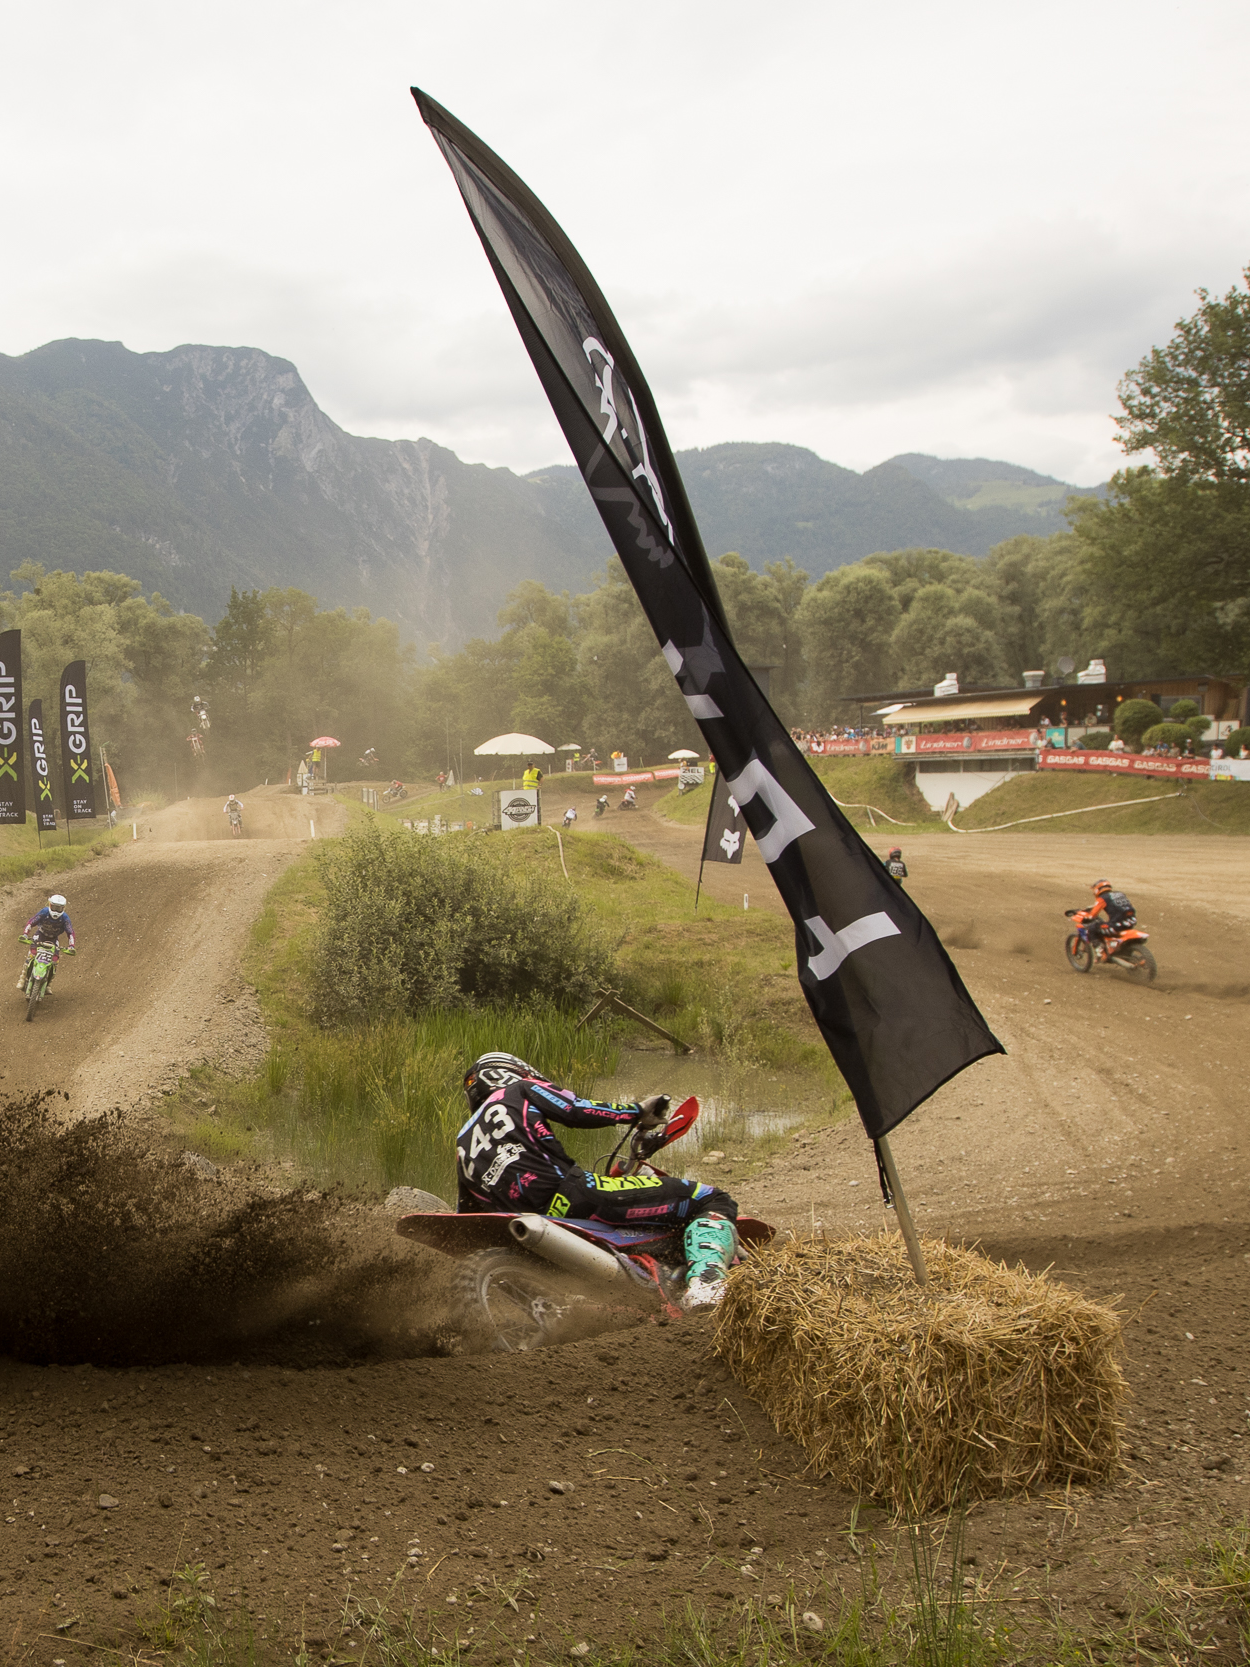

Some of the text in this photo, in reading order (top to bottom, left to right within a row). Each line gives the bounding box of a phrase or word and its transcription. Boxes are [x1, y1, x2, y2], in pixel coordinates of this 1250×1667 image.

[65, 684, 90, 783] X-GRIP
[827, 743, 858, 752] Lindner
[871, 742, 889, 751] KTM
[920, 740, 962, 749] Lindner
[982, 737, 1028, 748] Lindner
[31, 718, 52, 801] X-GRIP
[1047, 755, 1085, 765] GASGAS
[1089, 756, 1130, 768] GASGAS
[1134, 760, 1177, 772] GASGAS
